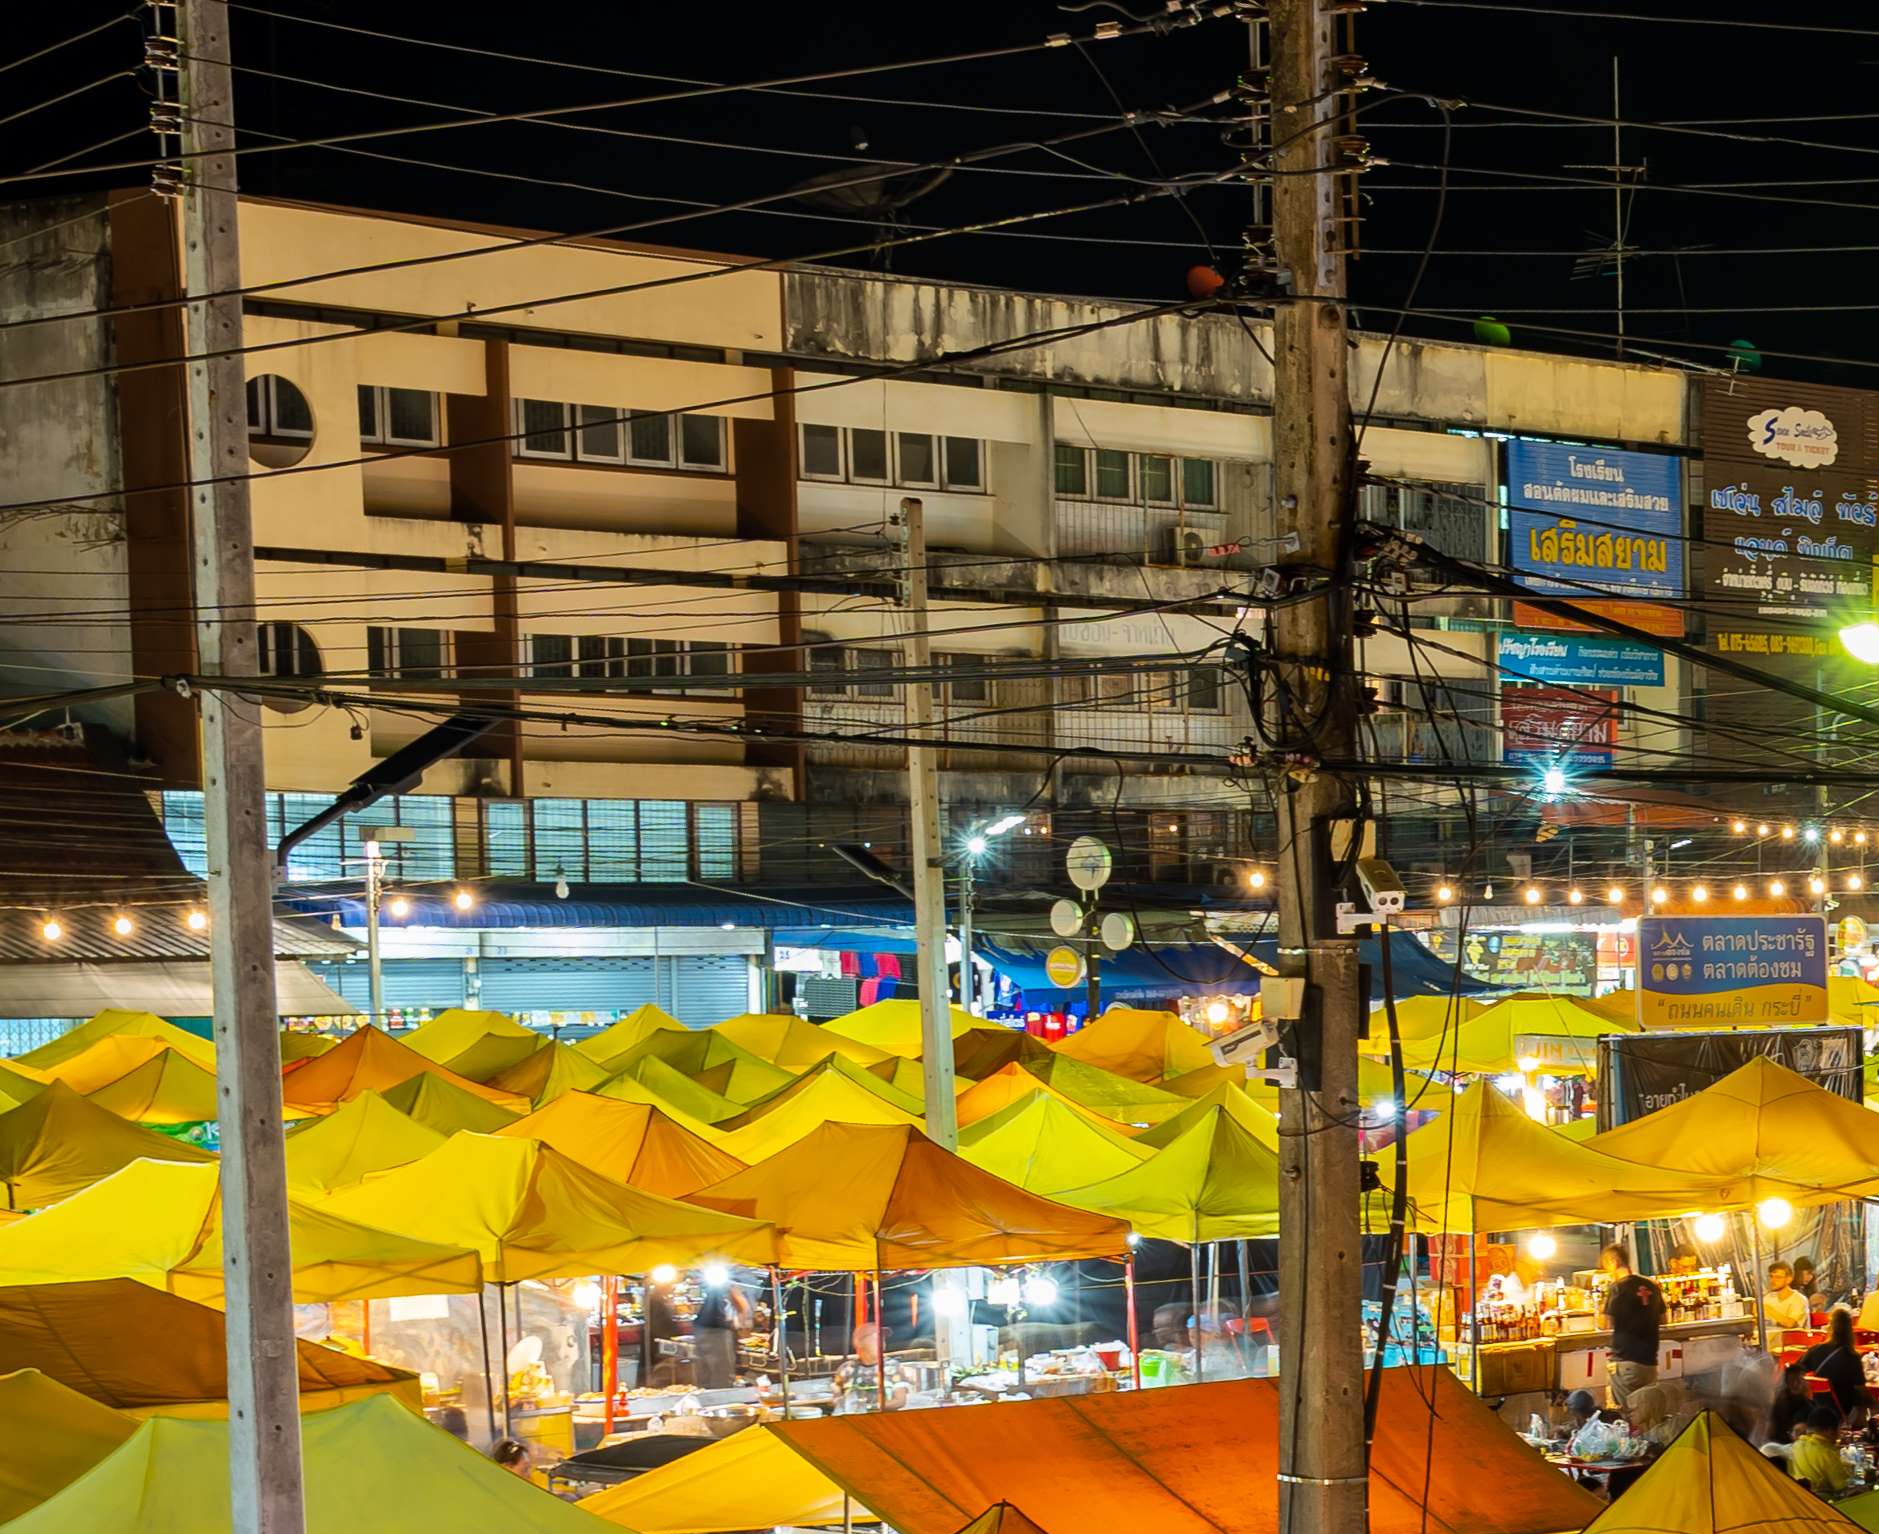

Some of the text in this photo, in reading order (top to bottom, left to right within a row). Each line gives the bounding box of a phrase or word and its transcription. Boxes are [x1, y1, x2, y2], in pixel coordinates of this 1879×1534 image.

[1703, 927, 1815, 957] ตลาดประชารัฐ
[1703, 956, 1801, 979] ตลาดต้องชม
